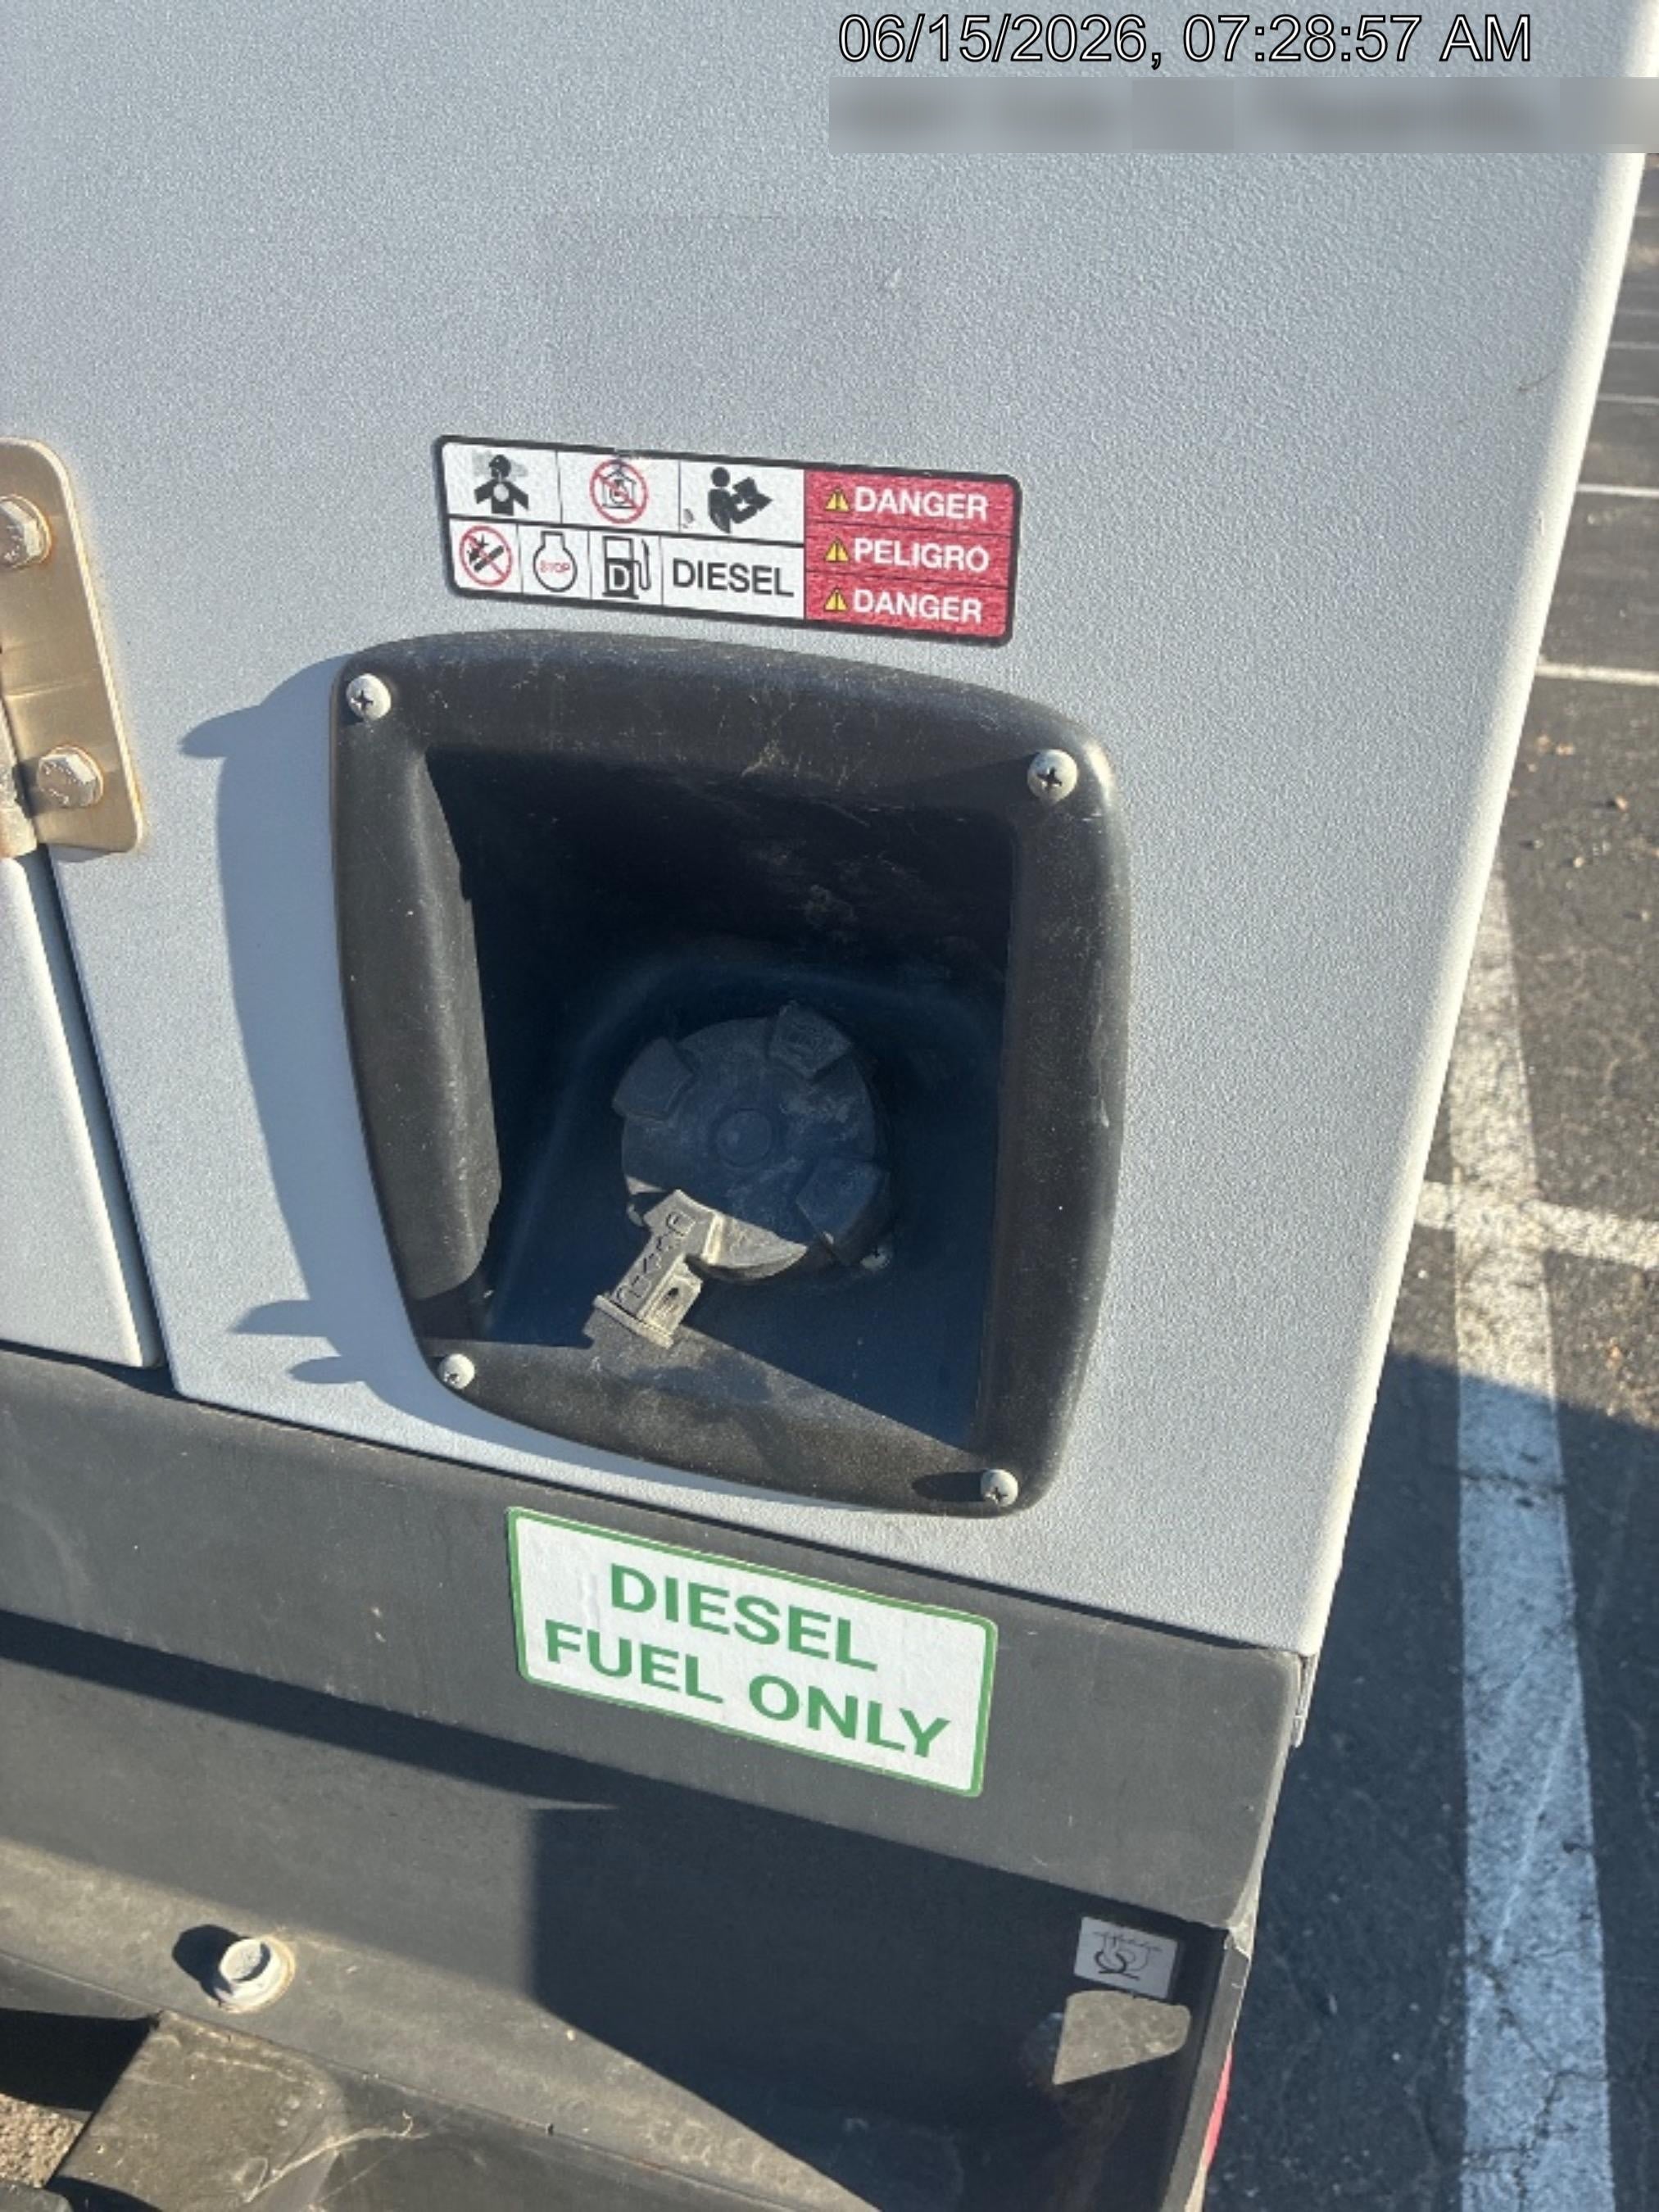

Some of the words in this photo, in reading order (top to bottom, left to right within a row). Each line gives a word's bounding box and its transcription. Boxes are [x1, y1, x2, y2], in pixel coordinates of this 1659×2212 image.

[854, 486, 989, 521] DANGER
[540, 560, 571, 573] STOP
[854, 537, 990, 573] PELIGRO
[672, 557, 795, 597] DIESEL
[853, 588, 982, 623] DANGER
[610, 1562, 878, 1672] DIESEL
[545, 1619, 723, 1704] FUEL
[748, 1674, 950, 1759] ONLY
